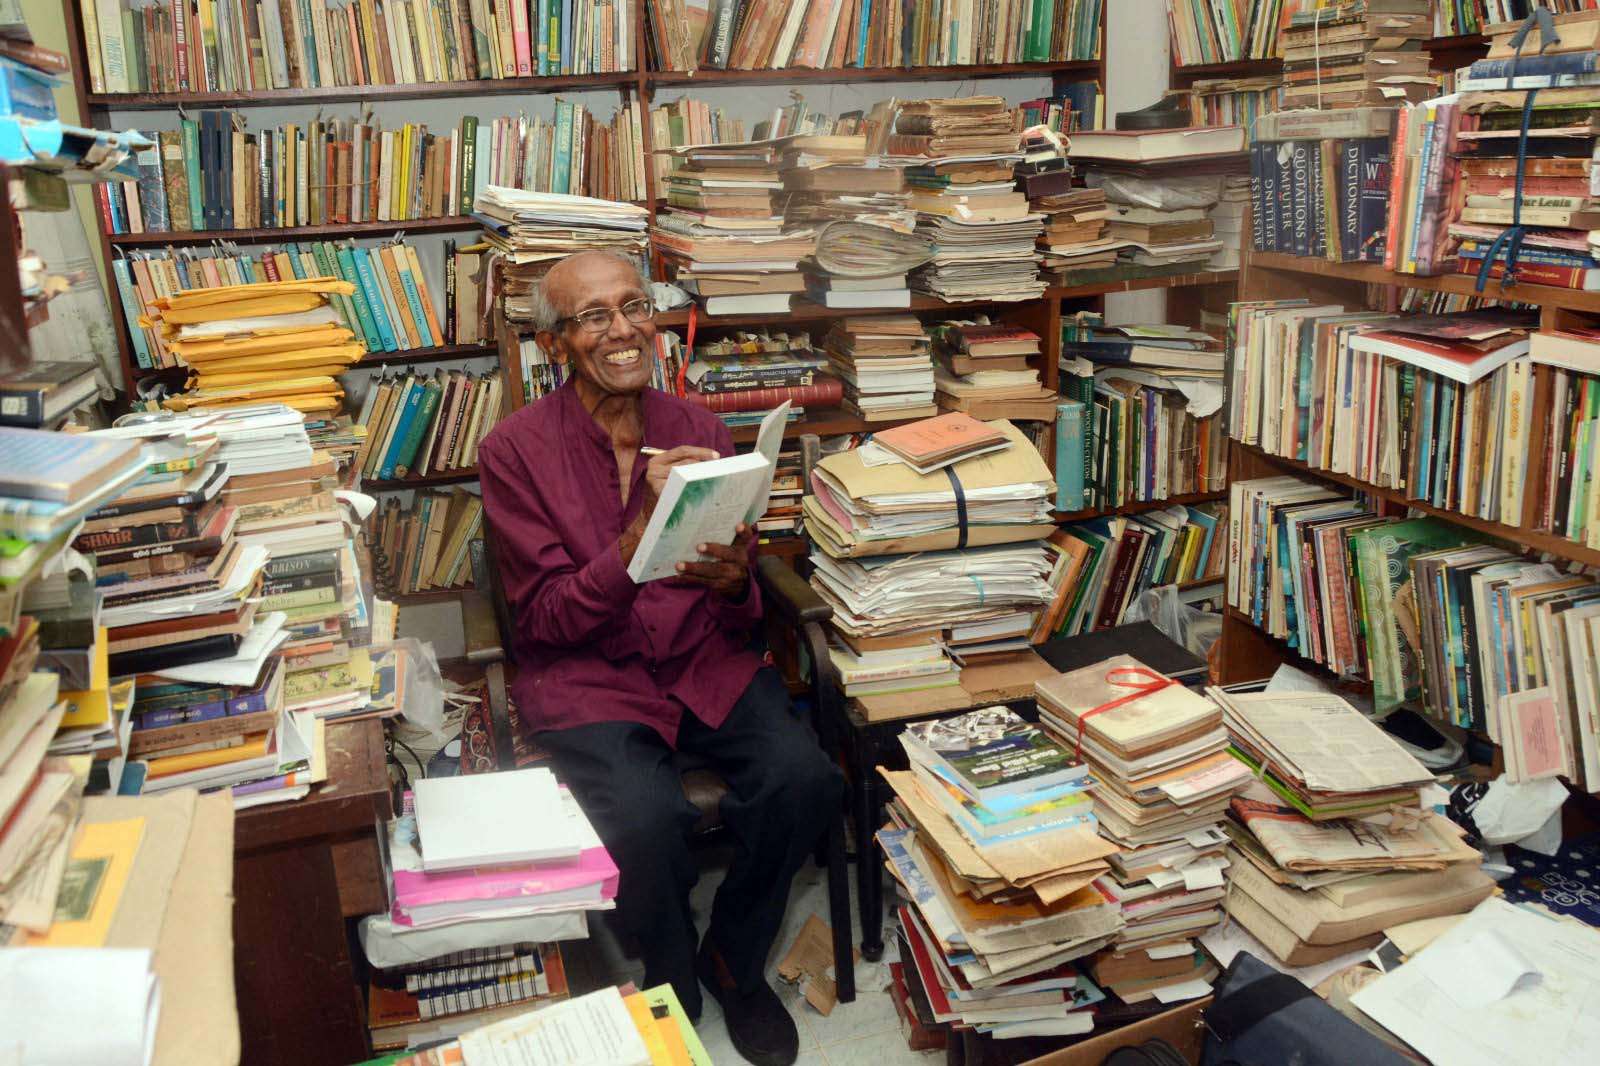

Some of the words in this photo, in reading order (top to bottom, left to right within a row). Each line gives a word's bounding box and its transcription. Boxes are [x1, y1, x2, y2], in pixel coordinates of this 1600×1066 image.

[1252, 177, 1262, 244] BUSINESS
[1265, 179, 1274, 245] SPELLING
[1281, 160, 1292, 230] OMPUTER
[1295, 148, 1306, 238] QUOTATIONS
[1348, 148, 1358, 235] DICTIONARY
[1522, 198, 1536, 207] ur
[1538, 197, 1572, 208] Lenin
[82, 528, 133, 547] SHMiR
[265, 560, 311, 577] RRISON
